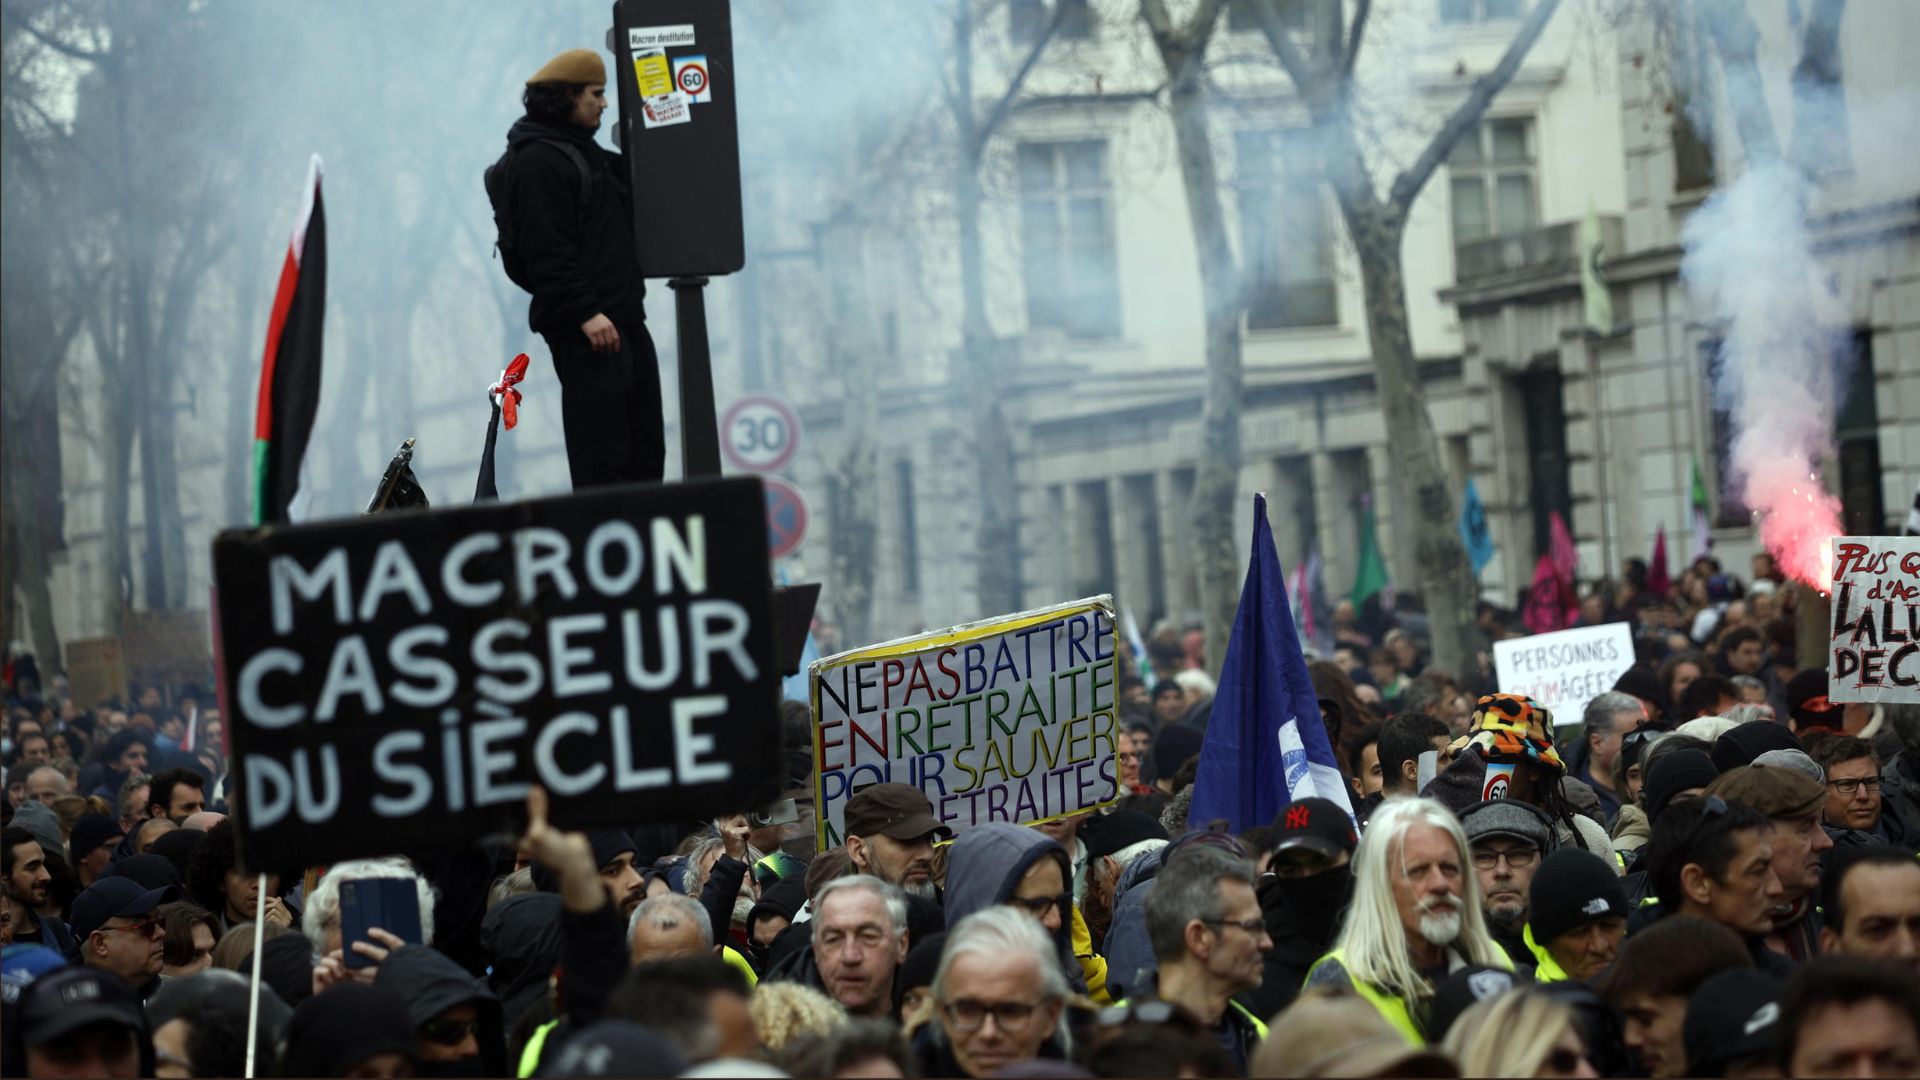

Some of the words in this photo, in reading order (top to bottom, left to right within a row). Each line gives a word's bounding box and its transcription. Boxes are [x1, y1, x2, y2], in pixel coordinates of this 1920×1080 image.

[632, 34, 656, 44] Macron
[658, 31, 694, 43] destitution
[683, 73, 702, 87] 60
[737, 416, 785, 452] 30
[269, 514, 707, 636] MACRON
[237, 599, 759, 729] CASSEUR
[1511, 637, 1619, 673] PERSONNES
[244, 744, 342, 831] DU
[928, 755, 1119, 844] ETRAITES
